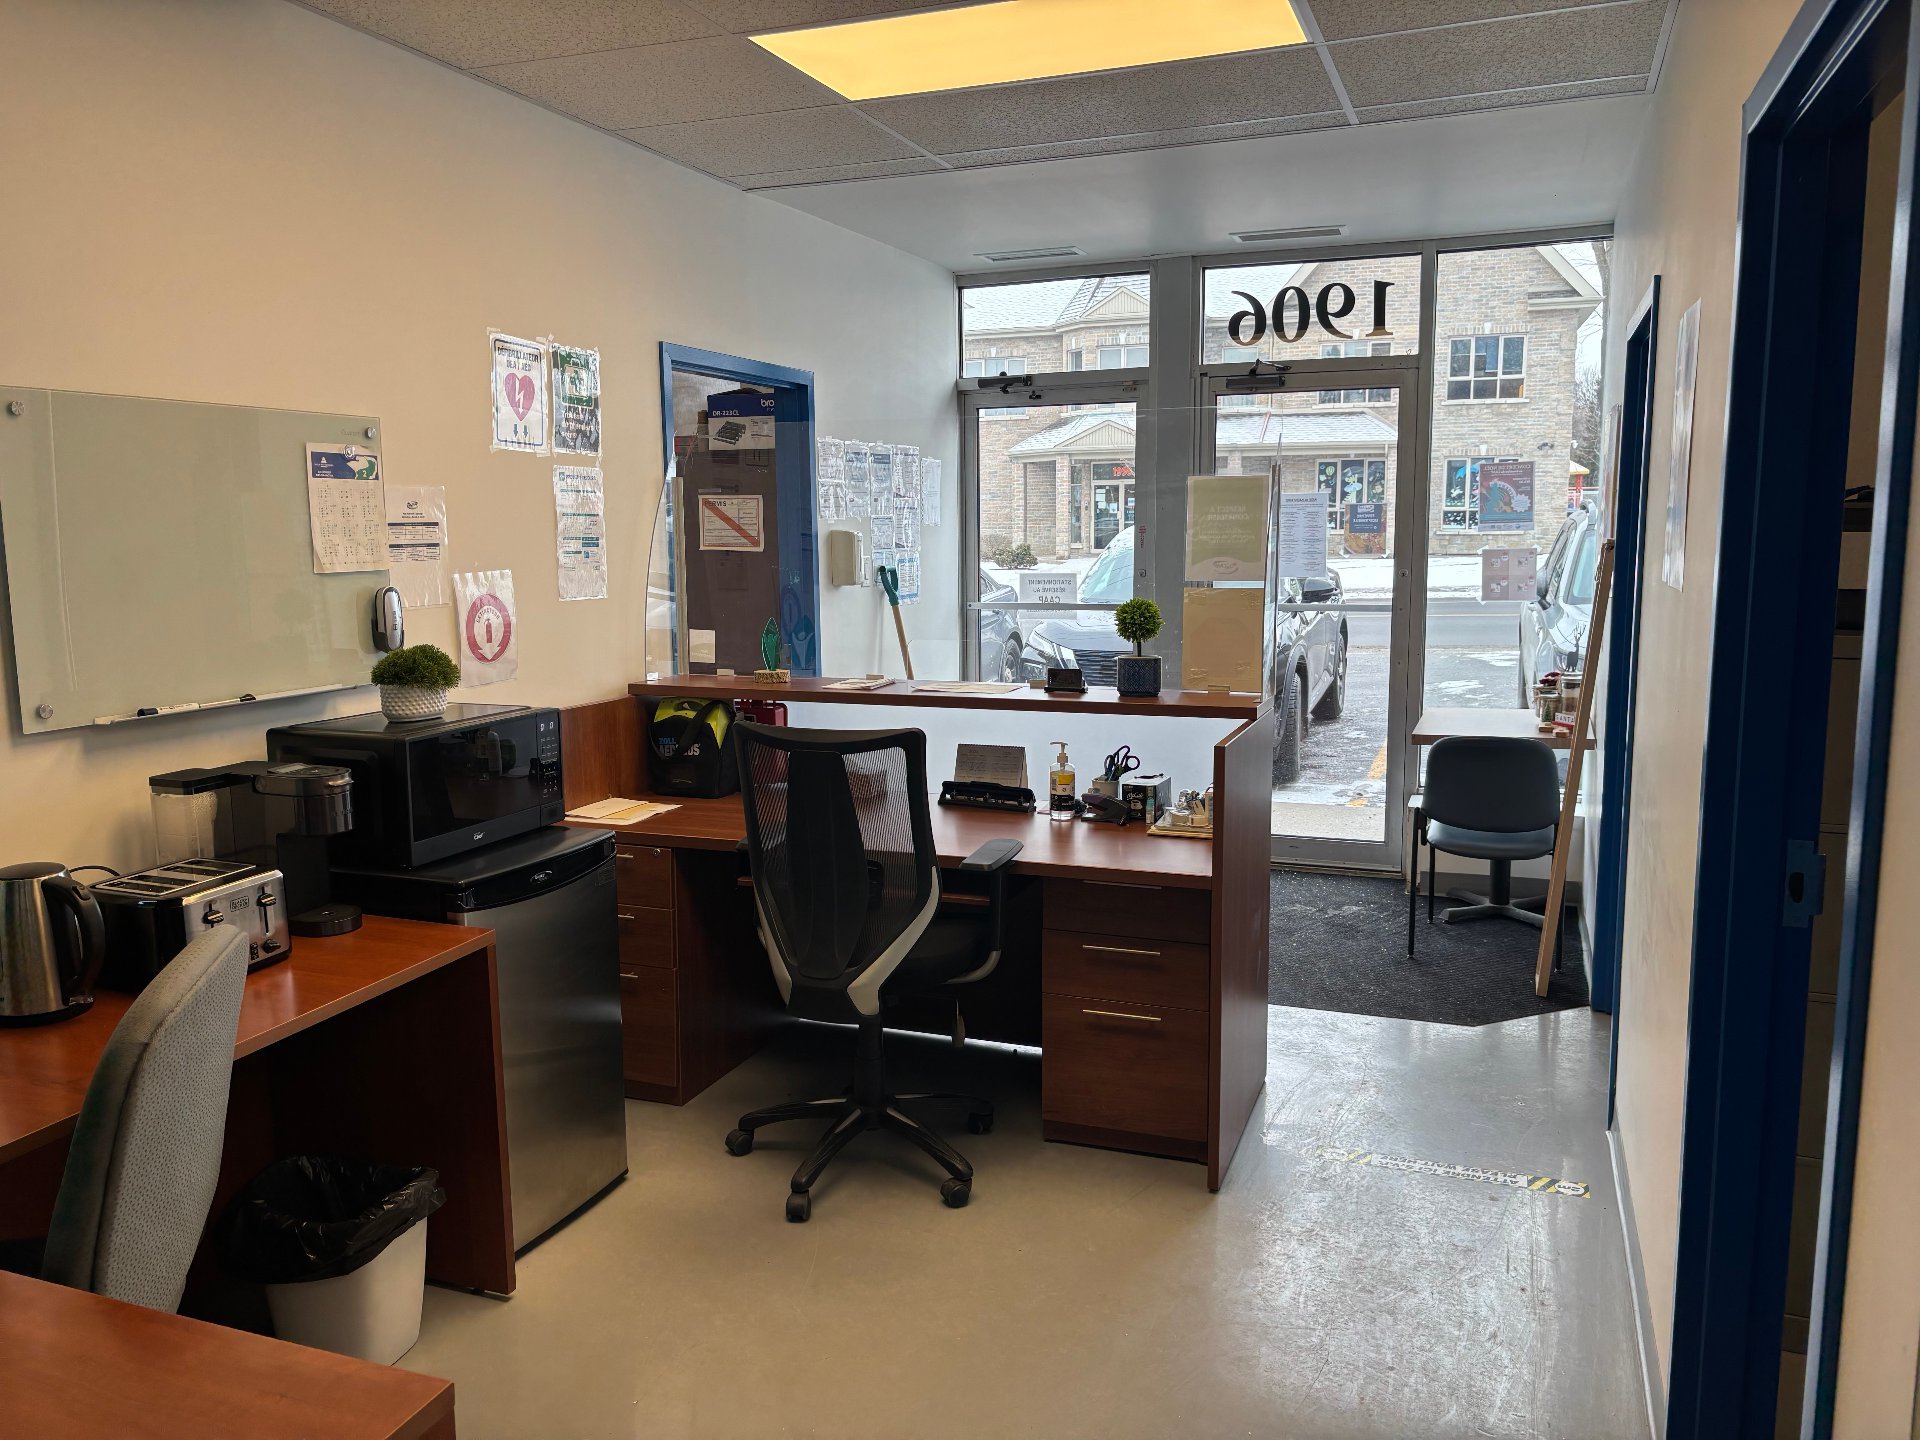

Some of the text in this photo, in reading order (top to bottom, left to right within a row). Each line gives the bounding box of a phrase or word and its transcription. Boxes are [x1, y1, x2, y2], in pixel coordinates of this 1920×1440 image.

[1556, 714, 1575, 723] SANTA
[1418, 1160, 1457, 1171] WAIT
[1442, 1168, 1520, 1185] ATTENDRE
[1462, 1166, 1518, 1180] PLEASE
